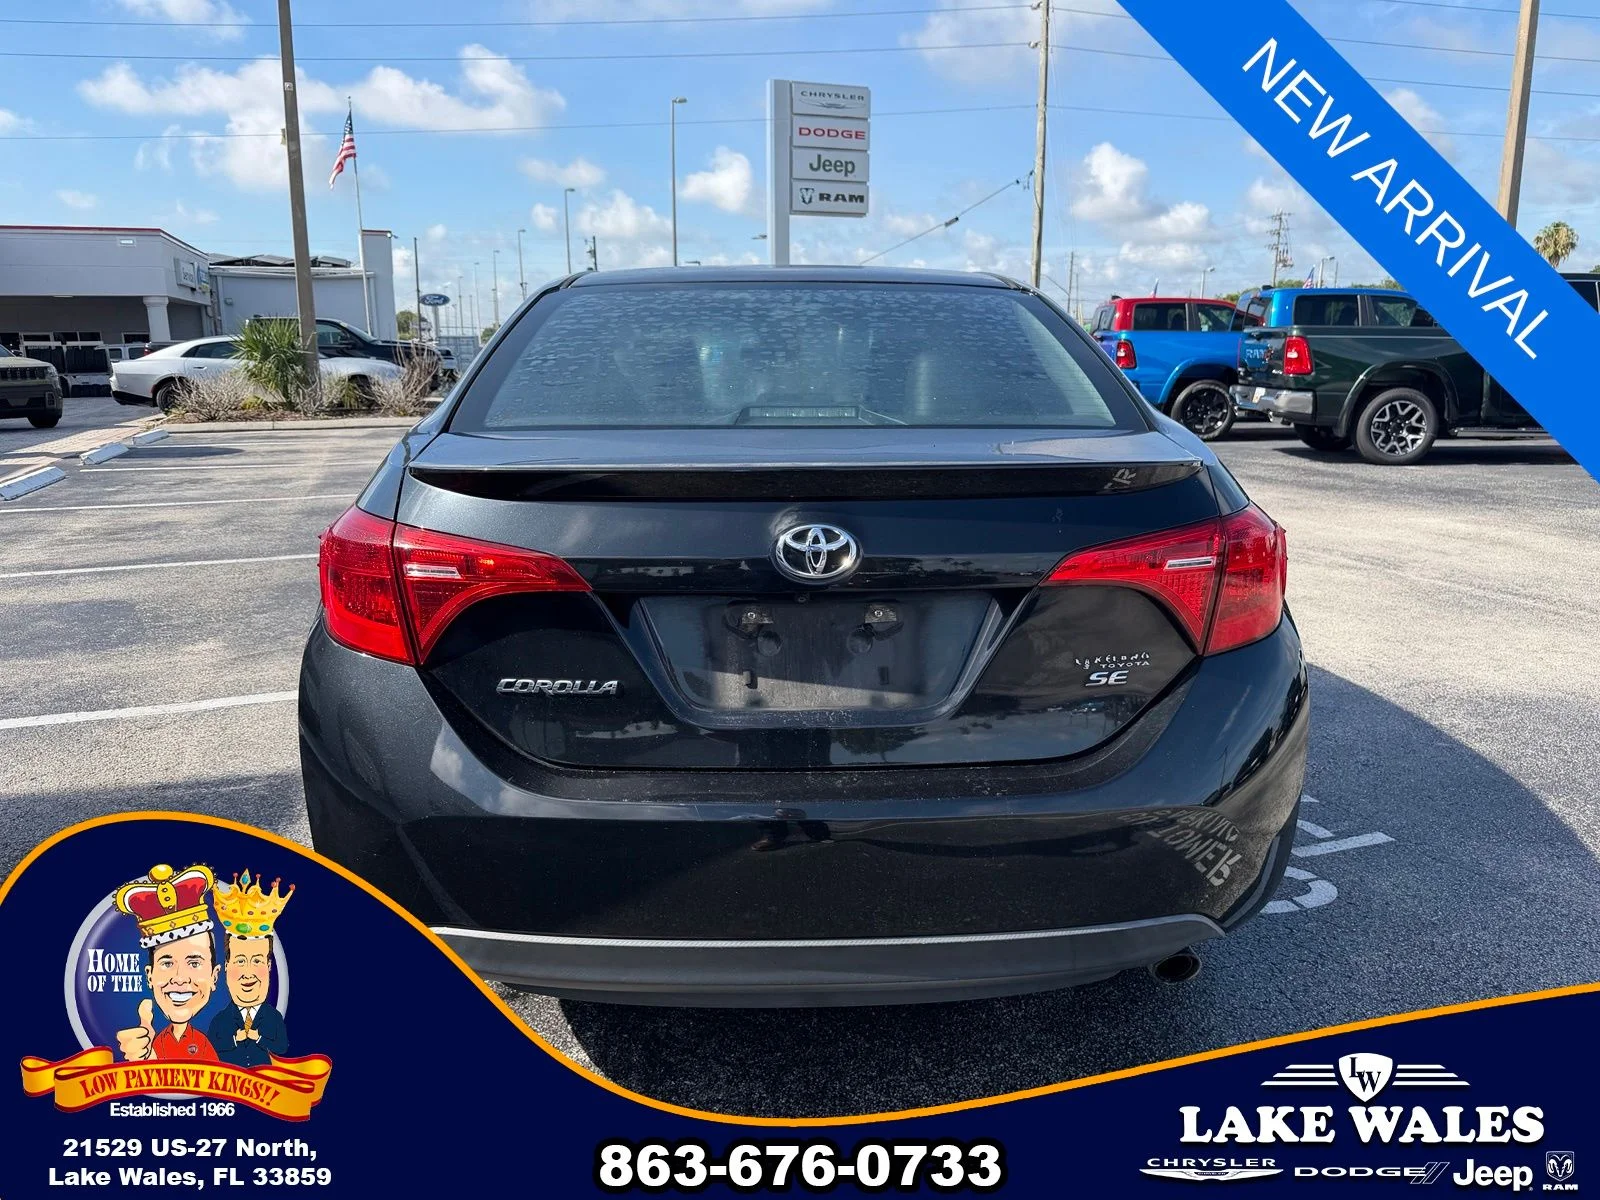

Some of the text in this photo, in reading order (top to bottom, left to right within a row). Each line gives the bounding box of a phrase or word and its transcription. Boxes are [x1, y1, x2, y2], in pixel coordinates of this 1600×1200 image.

[800, 90, 865, 101] CHRYSLER
[798, 127, 866, 140] DODGE
[809, 153, 856, 177] Jeep
[818, 192, 865, 204] RAM
[1100, 660, 1151, 669] TOYOTA
[1085, 670, 1129, 687] SE
[496, 678, 618, 696] COROLLA
